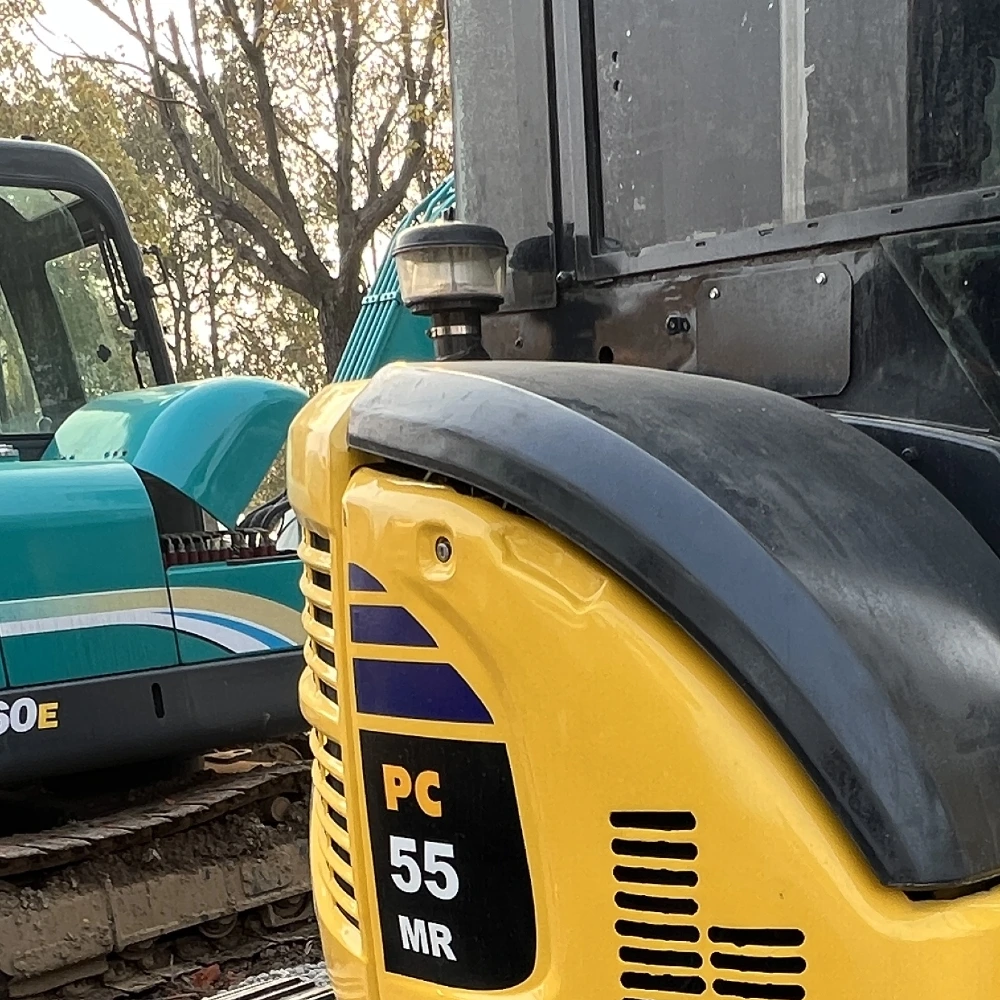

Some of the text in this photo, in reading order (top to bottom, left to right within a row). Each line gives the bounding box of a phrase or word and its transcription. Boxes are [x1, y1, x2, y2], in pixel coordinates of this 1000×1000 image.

[382, 763, 442, 818] PC
[389, 834, 460, 901] 55
[398, 914, 458, 962] MR
